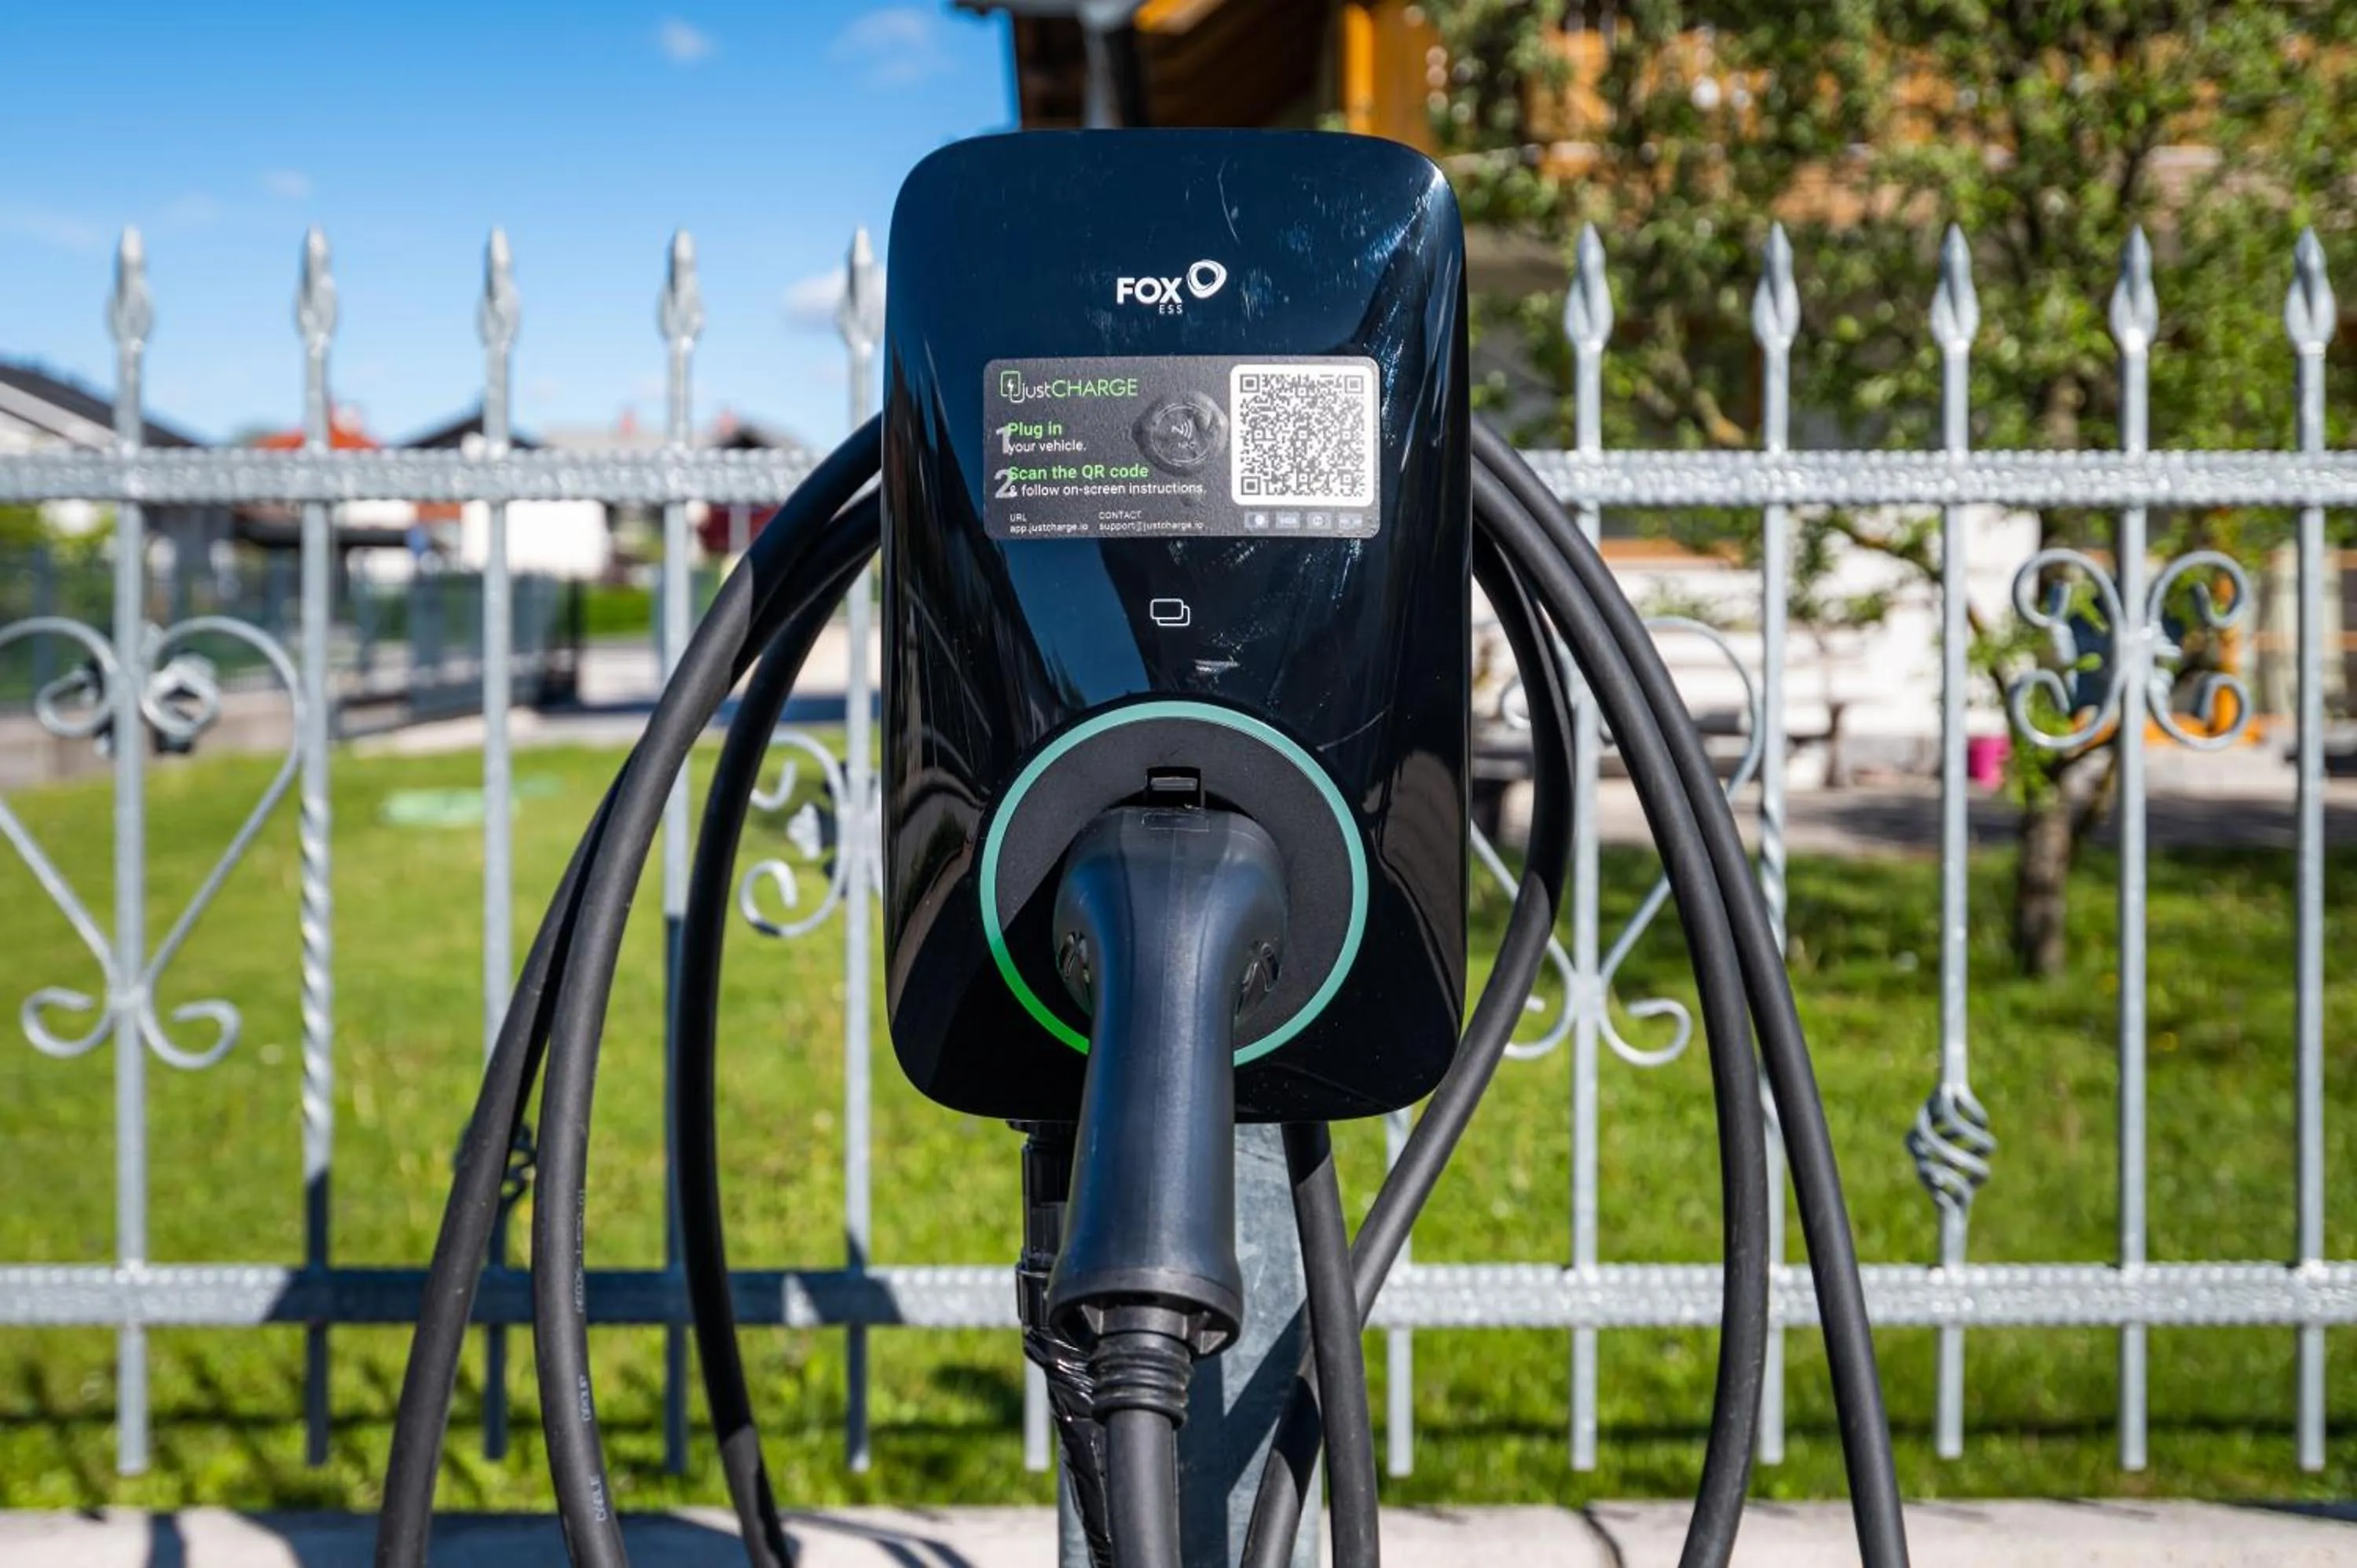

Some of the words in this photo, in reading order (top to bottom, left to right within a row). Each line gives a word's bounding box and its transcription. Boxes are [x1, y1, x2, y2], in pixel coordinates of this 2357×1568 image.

[1116, 277, 1182, 305] FOX
[1159, 304, 1182, 314] ESS
[1021, 378, 1138, 402] justCHARGE
[1008, 421, 1043, 439] Plug
[1048, 421, 1062, 435] in
[1008, 442, 1036, 456] your
[1039, 439, 1087, 452] vehicle.
[1009, 467, 1047, 481] Scan
[1051, 464, 1077, 479] the
[1081, 464, 1105, 480] QR
[1110, 463, 1149, 478] code
[1010, 485, 1018, 496] &
[1021, 483, 1060, 496] follow
[1063, 482, 1126, 496] on-screen
[1128, 481, 1208, 495] instructions.
[1010, 513, 1027, 522] URL
[1098, 510, 1142, 519] CONTACT
